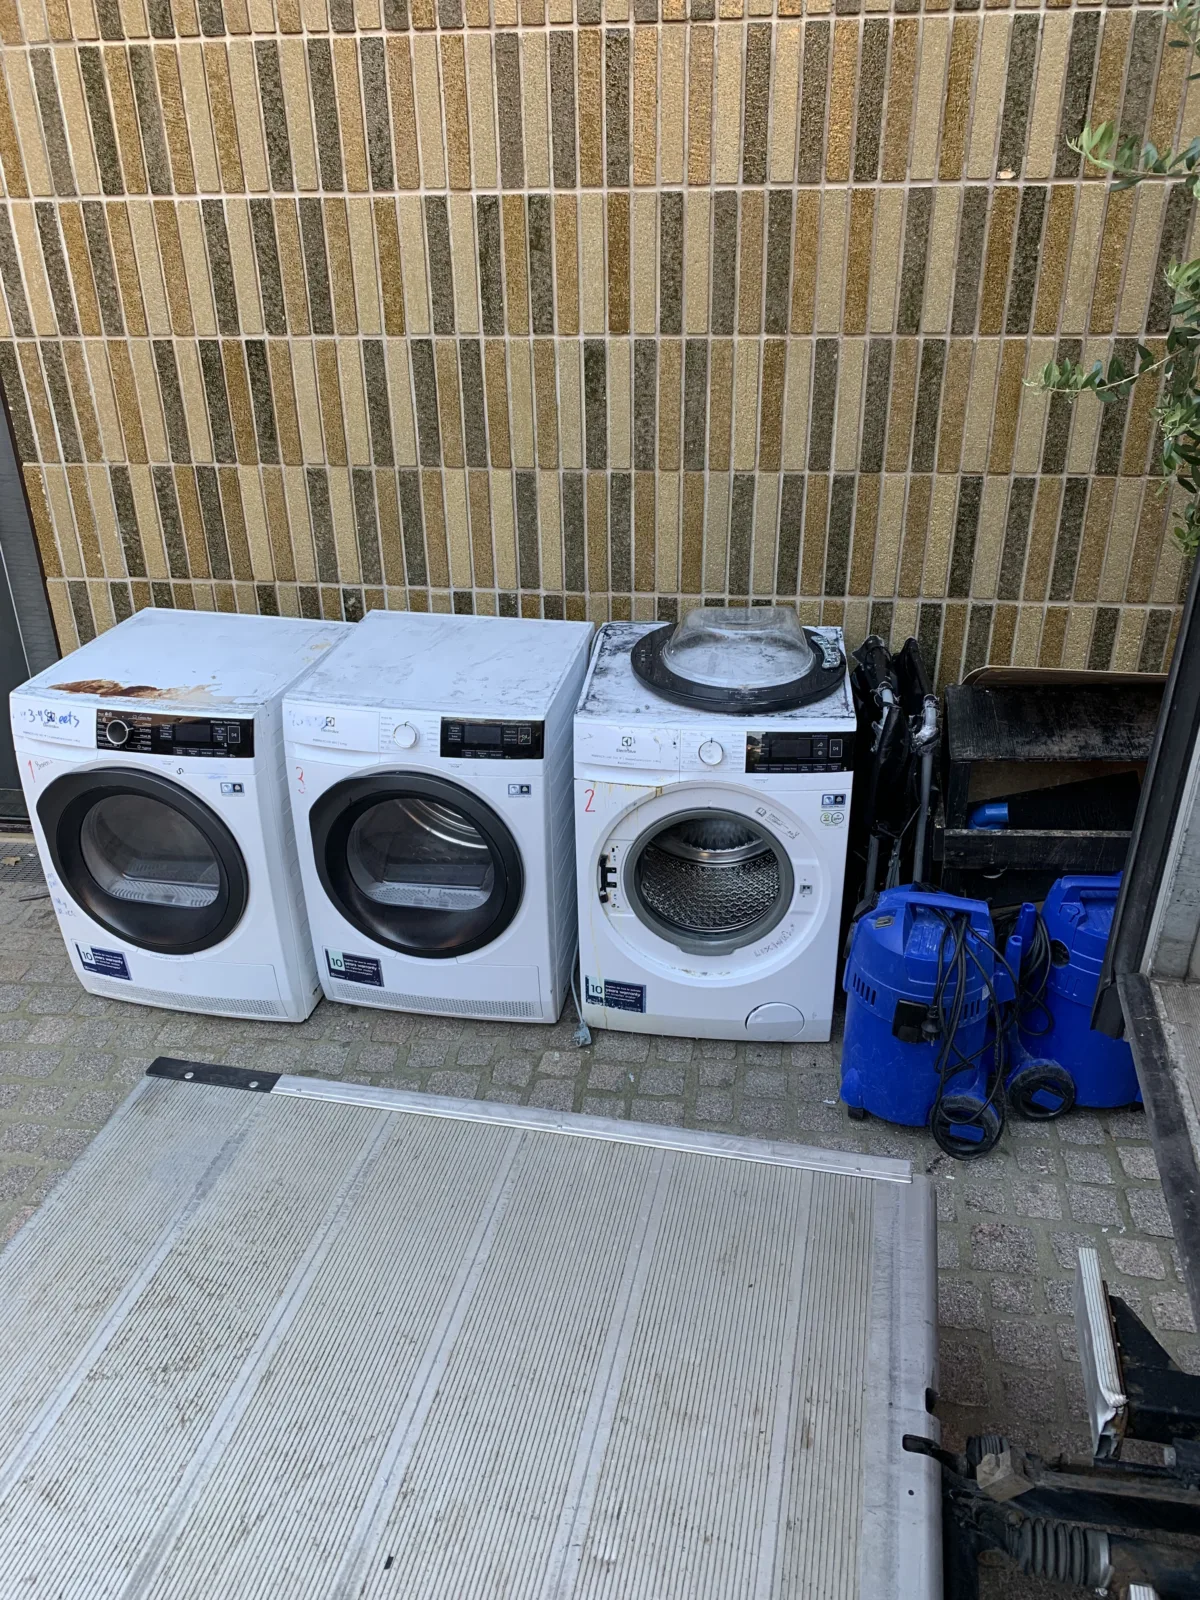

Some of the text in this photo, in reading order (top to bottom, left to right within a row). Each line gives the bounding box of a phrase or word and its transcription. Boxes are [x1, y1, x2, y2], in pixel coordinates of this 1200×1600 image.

[295, 766, 306, 794] 3
[584, 788, 596, 813] 2
[81, 951, 94, 961] 10
[331, 957, 344, 968] 10
[590, 984, 603, 995] 10
